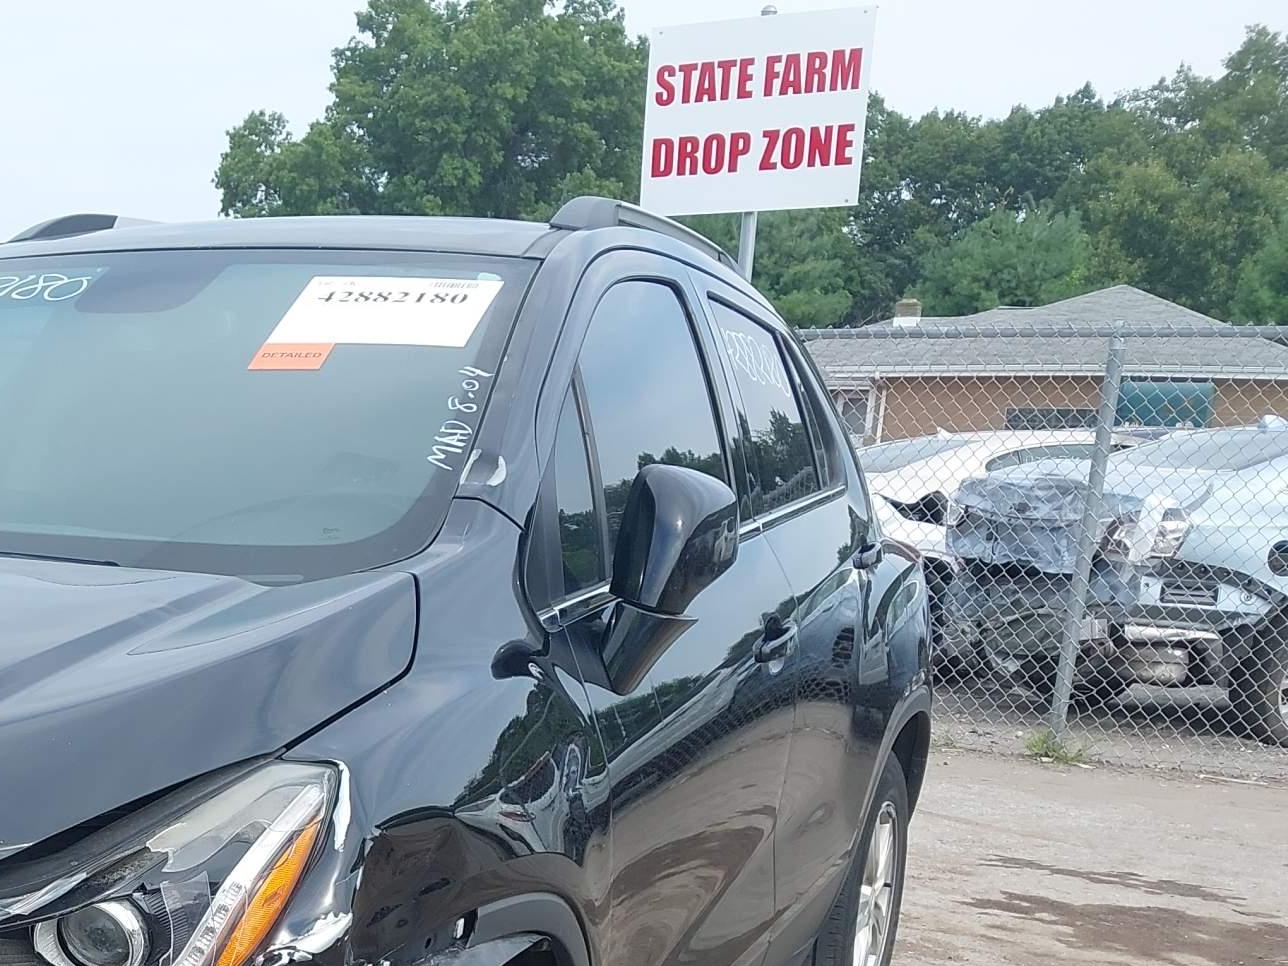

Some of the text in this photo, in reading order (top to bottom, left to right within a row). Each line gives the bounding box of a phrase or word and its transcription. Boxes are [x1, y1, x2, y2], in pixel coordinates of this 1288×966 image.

[655, 47, 863, 107] STATE FARM
[651, 123, 856, 178] DROP ZONE
[317, 291, 469, 304] 42882180
[261, 351, 323, 359] DETAILED
[426, 419, 473, 471] MAD
